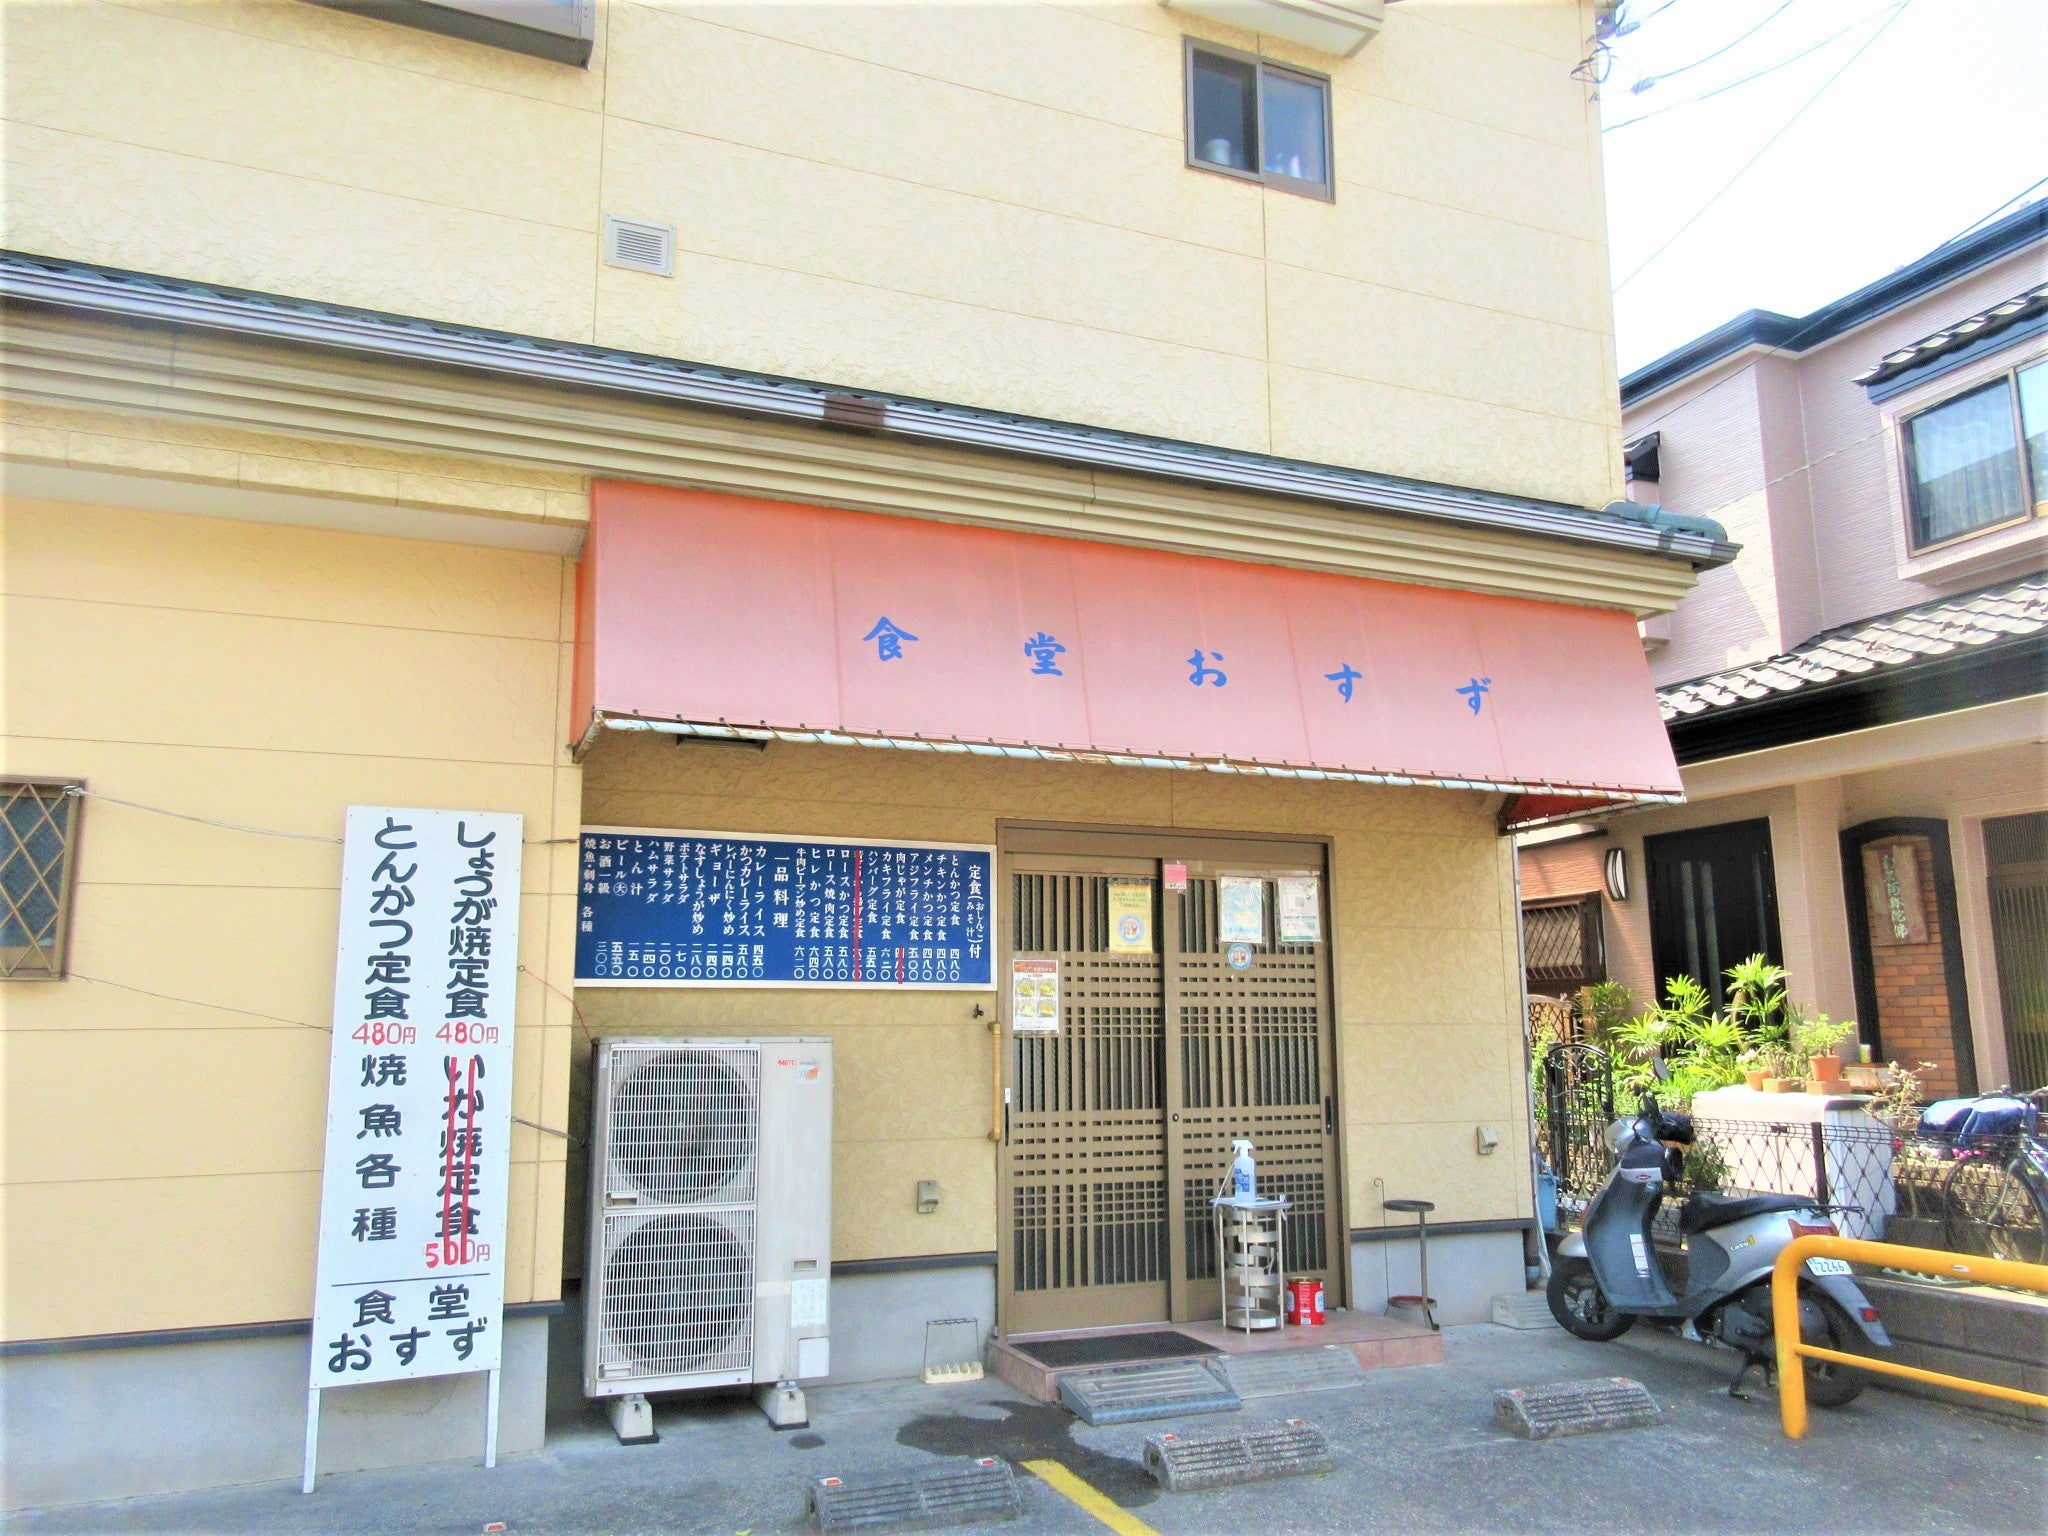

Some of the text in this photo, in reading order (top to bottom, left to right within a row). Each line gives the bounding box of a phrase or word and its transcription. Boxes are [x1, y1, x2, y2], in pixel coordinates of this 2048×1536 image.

[630, 840, 643, 896] とん汁
[646, 840, 660, 904] ハムサラダ
[661, 841, 675, 905] 野菜サラダ
[677, 843, 690, 905] ポテトサラダ
[708, 843, 722, 906] ギョーザ
[738, 845, 752, 937] かつカレーライス
[753, 845, 767, 937] カレーライス
[773, 856, 790, 928] 一品料理
[809, 848, 821, 939] ヒレかつ定食
[824, 849, 836, 939] ロース焼肉定食
[838, 849, 850, 939] ロースかつ定食
[867, 850, 879, 924] ハンバーグ定食
[881, 851, 892, 940] カキフライ定食
[909, 853, 920, 941] アジフライ定食
[922, 853, 933, 941] メンチかつ定食
[936, 854, 947, 941] チキンかつ定食
[950, 854, 960, 927] とんかつ定食
[364, 816, 418, 1020] とんかつ定食
[444, 820, 498, 1019] しょうが焼定食
[351, 1021, 416, 1046] 480円
[435, 1021, 499, 1045] 480円
[351, 1053, 407, 1243] 焼魚各種
[328, 1316, 488, 1373] おすず
[352, 1283, 470, 1328] 食堂
